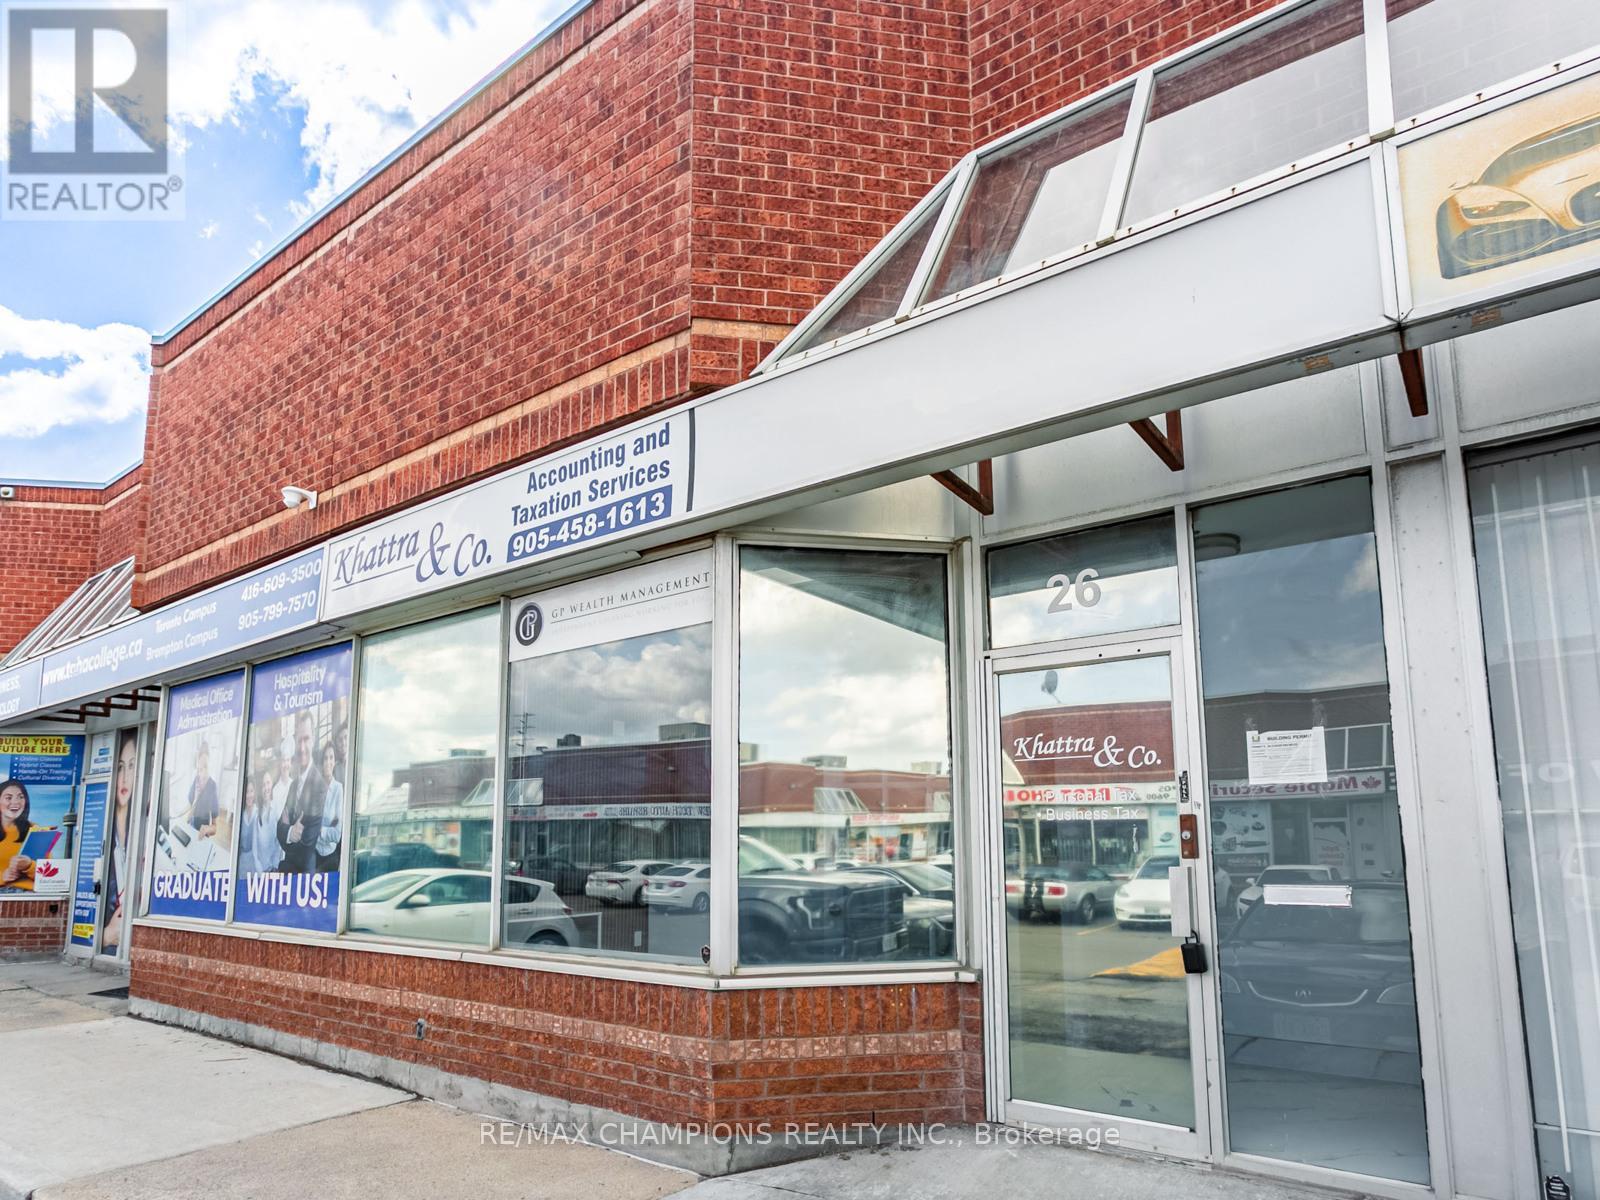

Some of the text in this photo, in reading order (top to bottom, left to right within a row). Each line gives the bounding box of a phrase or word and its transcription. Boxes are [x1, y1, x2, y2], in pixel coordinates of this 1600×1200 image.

[526, 421, 671, 494] Accounting and
[511, 459, 671, 527] Taxation Services
[512, 491, 666, 558] 905-458-1613
[332, 521, 493, 584] Khattra & Co.
[240, 558, 322, 601] 416-609-3500
[551, 607, 566, 620] GP
[569, 594, 615, 615] WEALTH
[619, 571, 711, 604] MANAGEMENT
[1046, 567, 1102, 615] 26
[154, 601, 217, 634] Toronto Campus
[237, 589, 317, 632] 905-799-7570
[183, 627, 218, 648] Campus
[273, 664, 327, 690] Hospitality
[180, 687, 234, 711] Medical Office
[273, 688, 323, 712] & Tourism
[177, 706, 233, 731] Administration
[32, 738, 64, 746] YOUR
[1013, 732, 1163, 769] Khattra & Co.
[1046, 787, 1138, 802] Prsonal Tax
[1045, 806, 1139, 822] Business Tax
[154, 871, 329, 909] GRADUATE WITH US!
